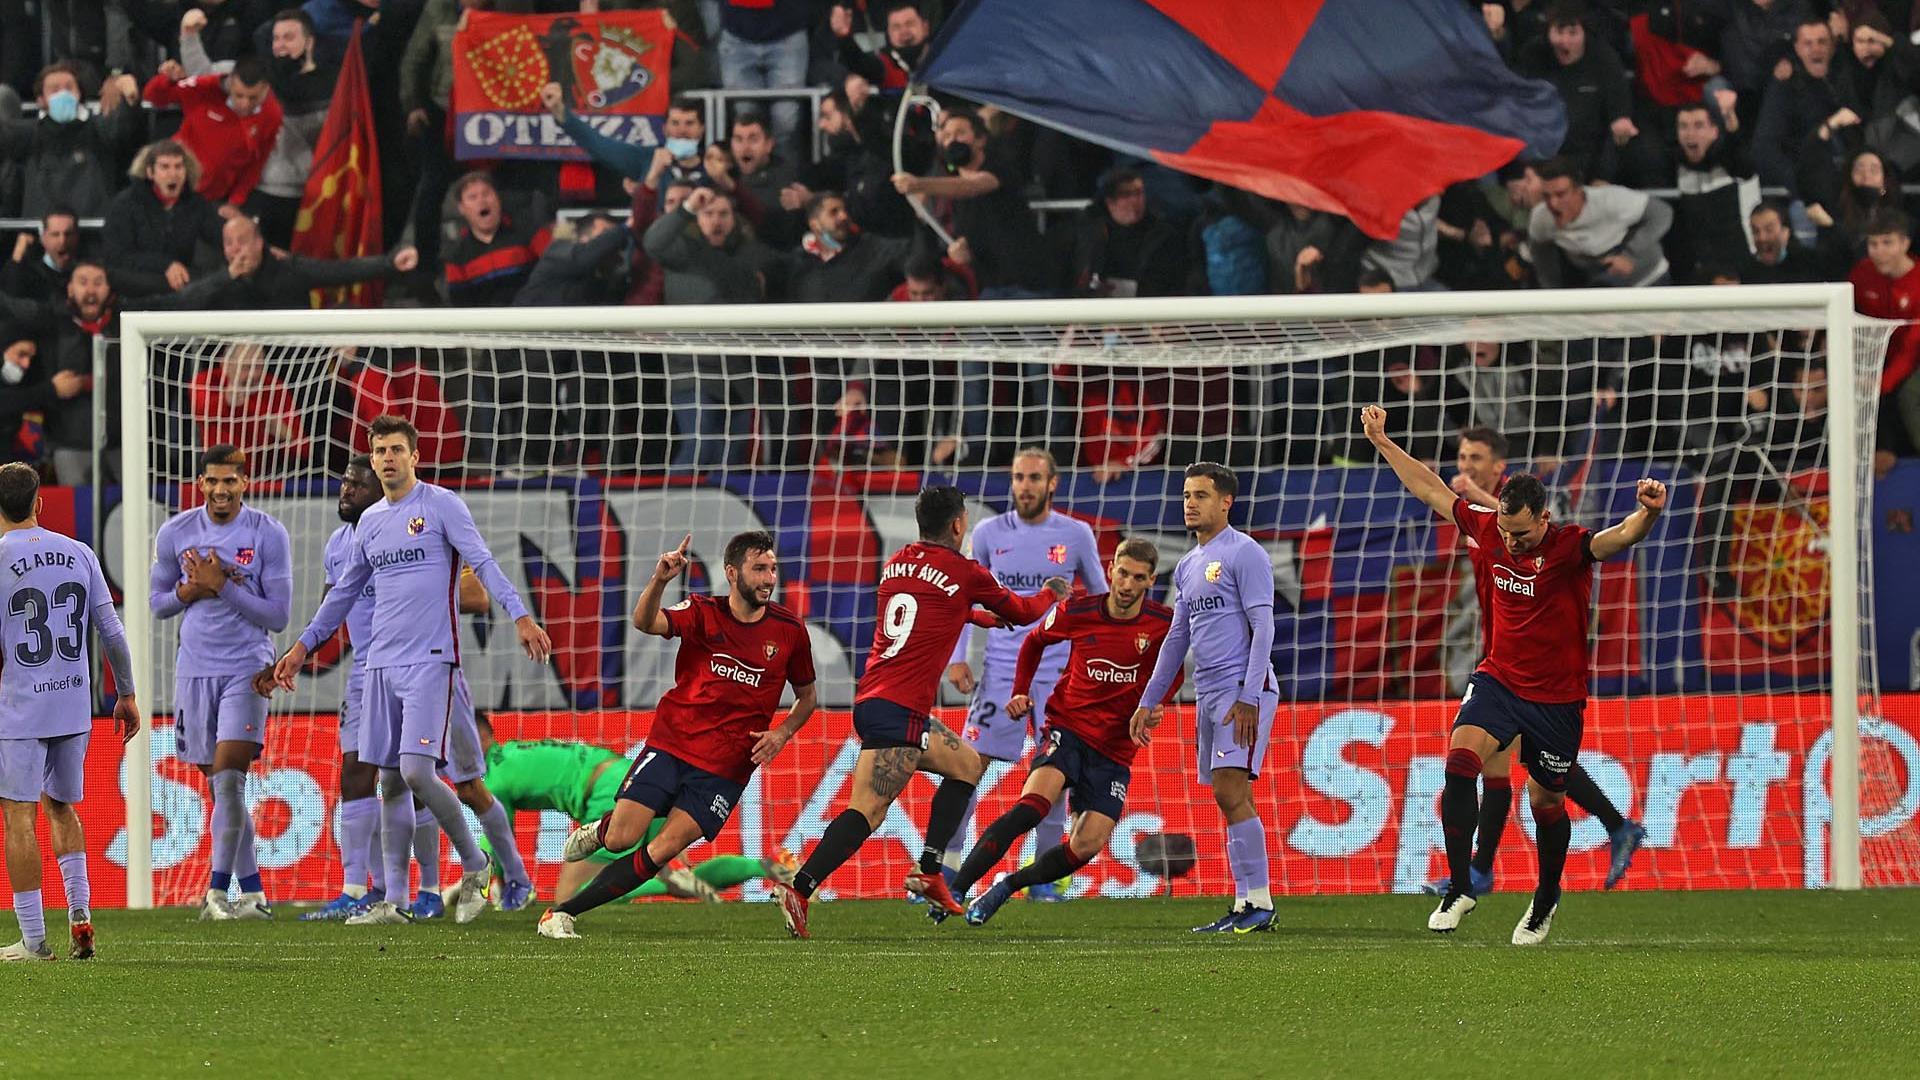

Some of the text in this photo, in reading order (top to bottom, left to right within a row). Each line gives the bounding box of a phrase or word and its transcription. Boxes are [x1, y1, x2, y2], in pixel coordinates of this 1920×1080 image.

[464, 113, 659, 147] OTEZA
[34, 551, 76, 570] ABDE
[369, 547, 426, 569] Rakuten
[880, 562, 960, 597] HIMY ÁVILA
[8, 581, 88, 668] 33
[880, 592, 918, 659] 9
[33, 675, 71, 694] unicef
[710, 659, 762, 688] verleal
[1086, 666, 1138, 683] verleal
[633, 751, 658, 776] 7
